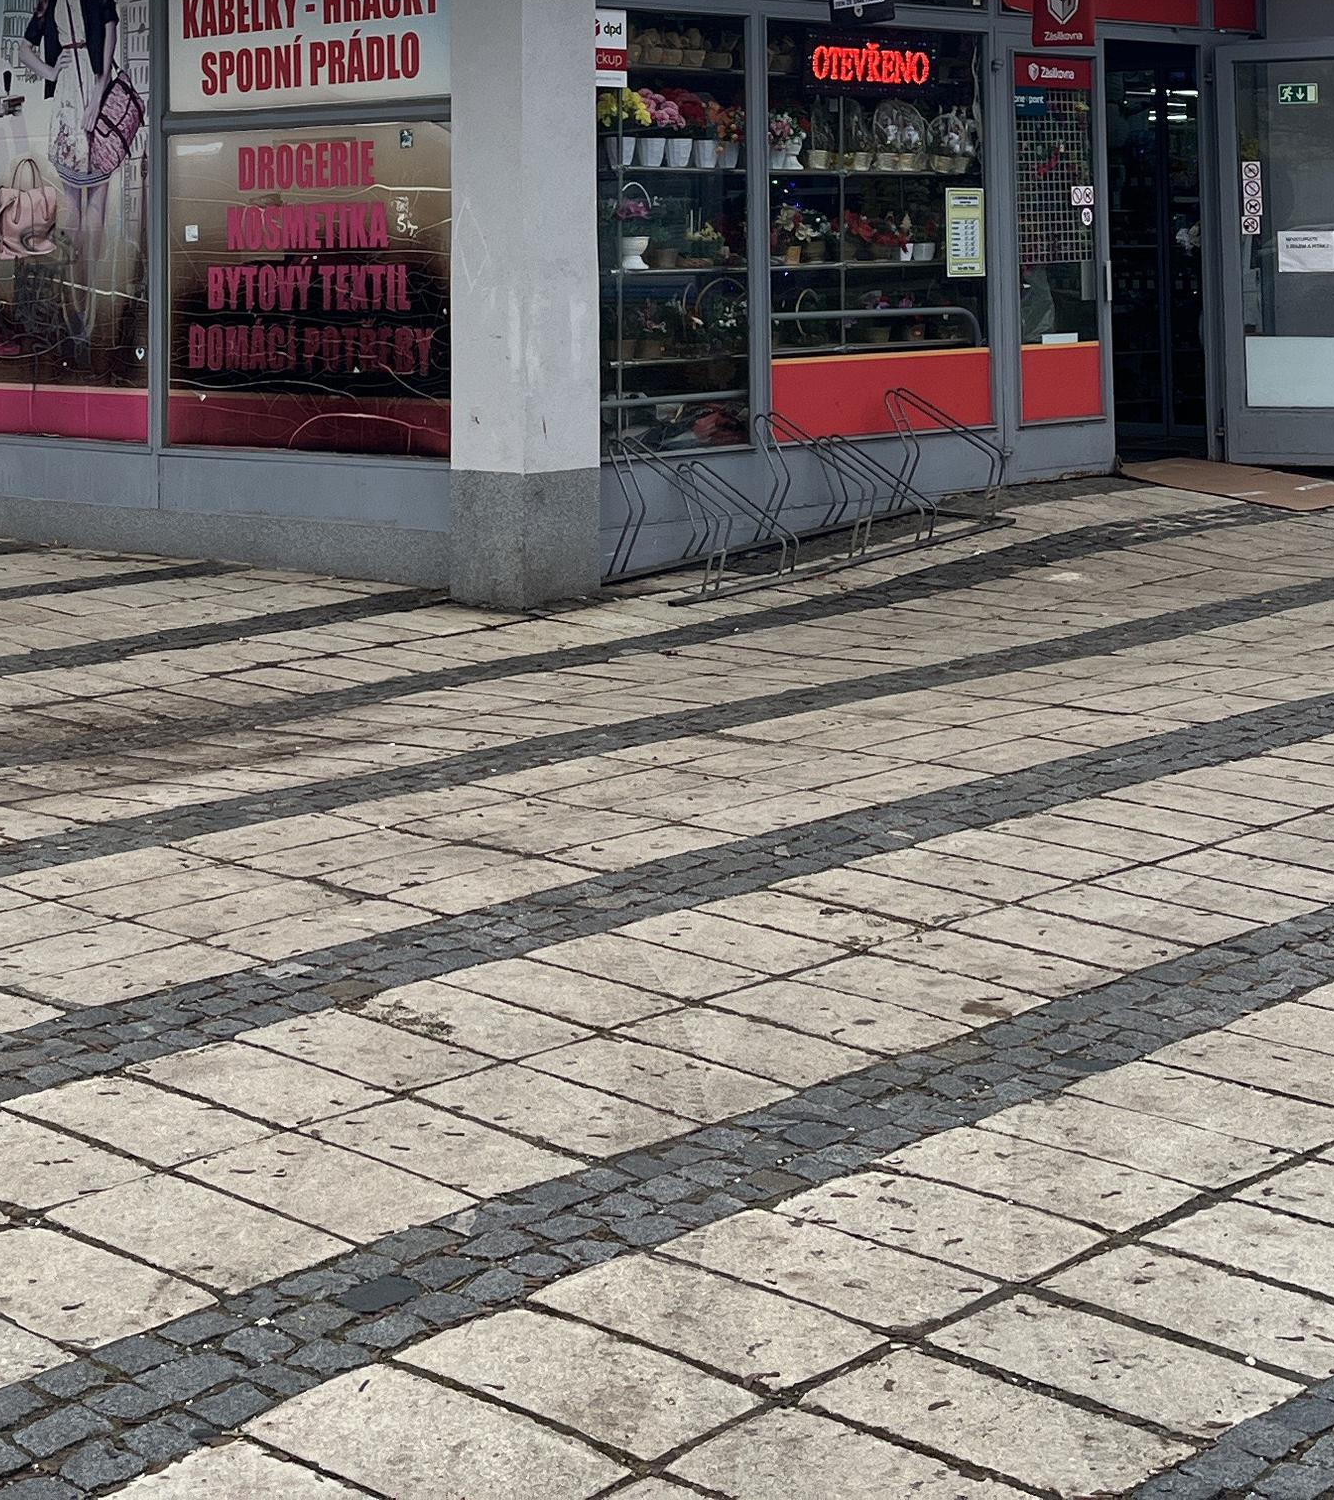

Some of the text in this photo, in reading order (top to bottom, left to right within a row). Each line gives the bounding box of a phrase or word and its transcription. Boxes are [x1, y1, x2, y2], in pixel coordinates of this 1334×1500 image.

[603, 22, 622, 37] dpd
[201, 29, 420, 96] SPODNÍ PRÁDLO
[597, 51, 623, 68] ckup
[813, 42, 930, 84] OTEVŘENO
[238, 140, 375, 191] DROGERIE
[227, 202, 389, 250] KOSMETIKA
[207, 257, 411, 311] BYTOVÝ TEXTIL
